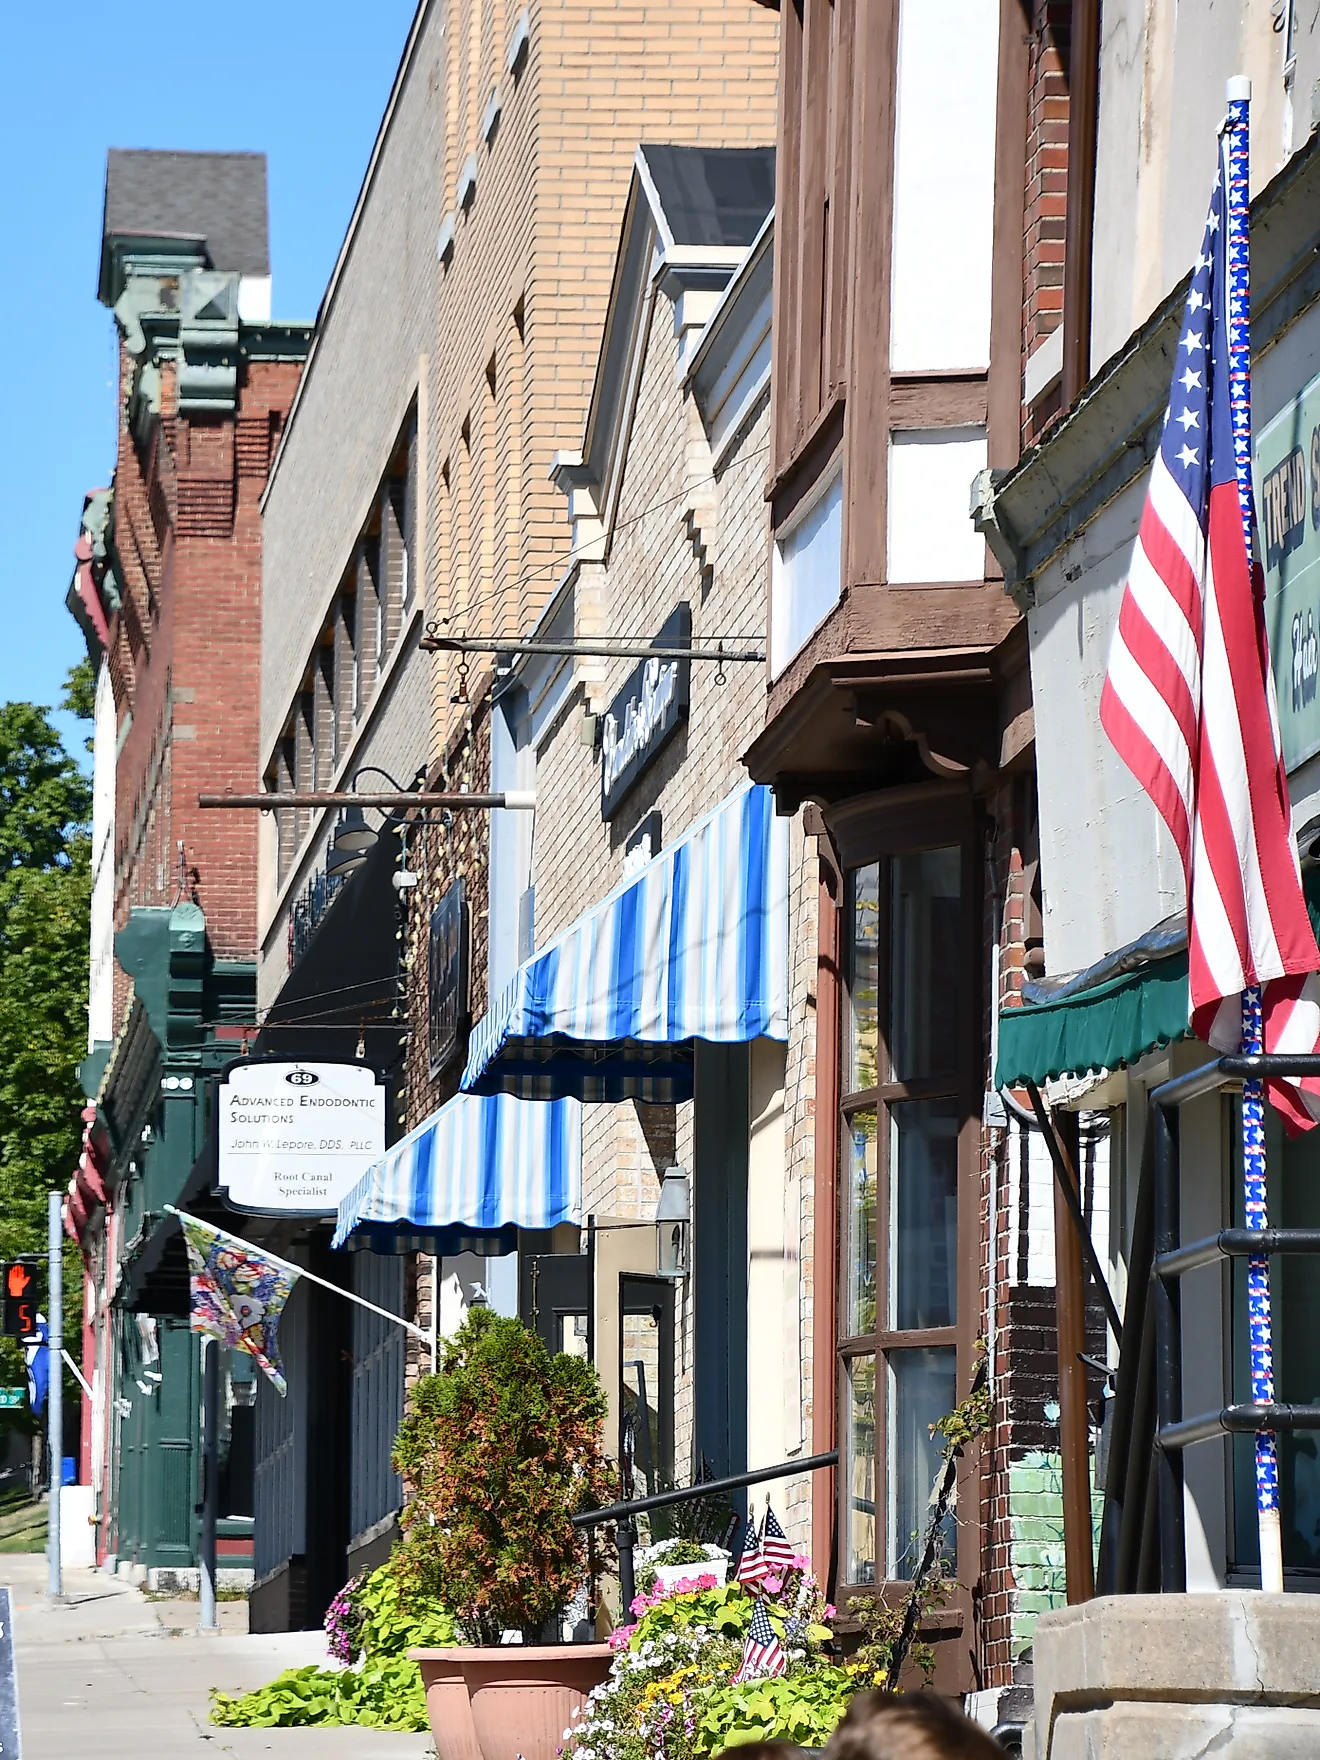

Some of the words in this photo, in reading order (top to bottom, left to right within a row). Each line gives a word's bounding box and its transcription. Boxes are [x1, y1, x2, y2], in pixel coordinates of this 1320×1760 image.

[1263, 450, 1306, 550] TREND
[290, 1073, 313, 1084] 69
[229, 1094, 295, 1107] ADVANCED
[299, 1095, 377, 1108] ENDODONTIC
[230, 1112, 294, 1124] SOLUTIONS
[231, 1139, 259, 1149] John
[350, 1140, 373, 1150] PLLC
[274, 1172, 299, 1181] Root
[302, 1172, 333, 1182] Canal
[279, 1187, 327, 1197] Specialist
[18, 1304, 31, 1333] 5
